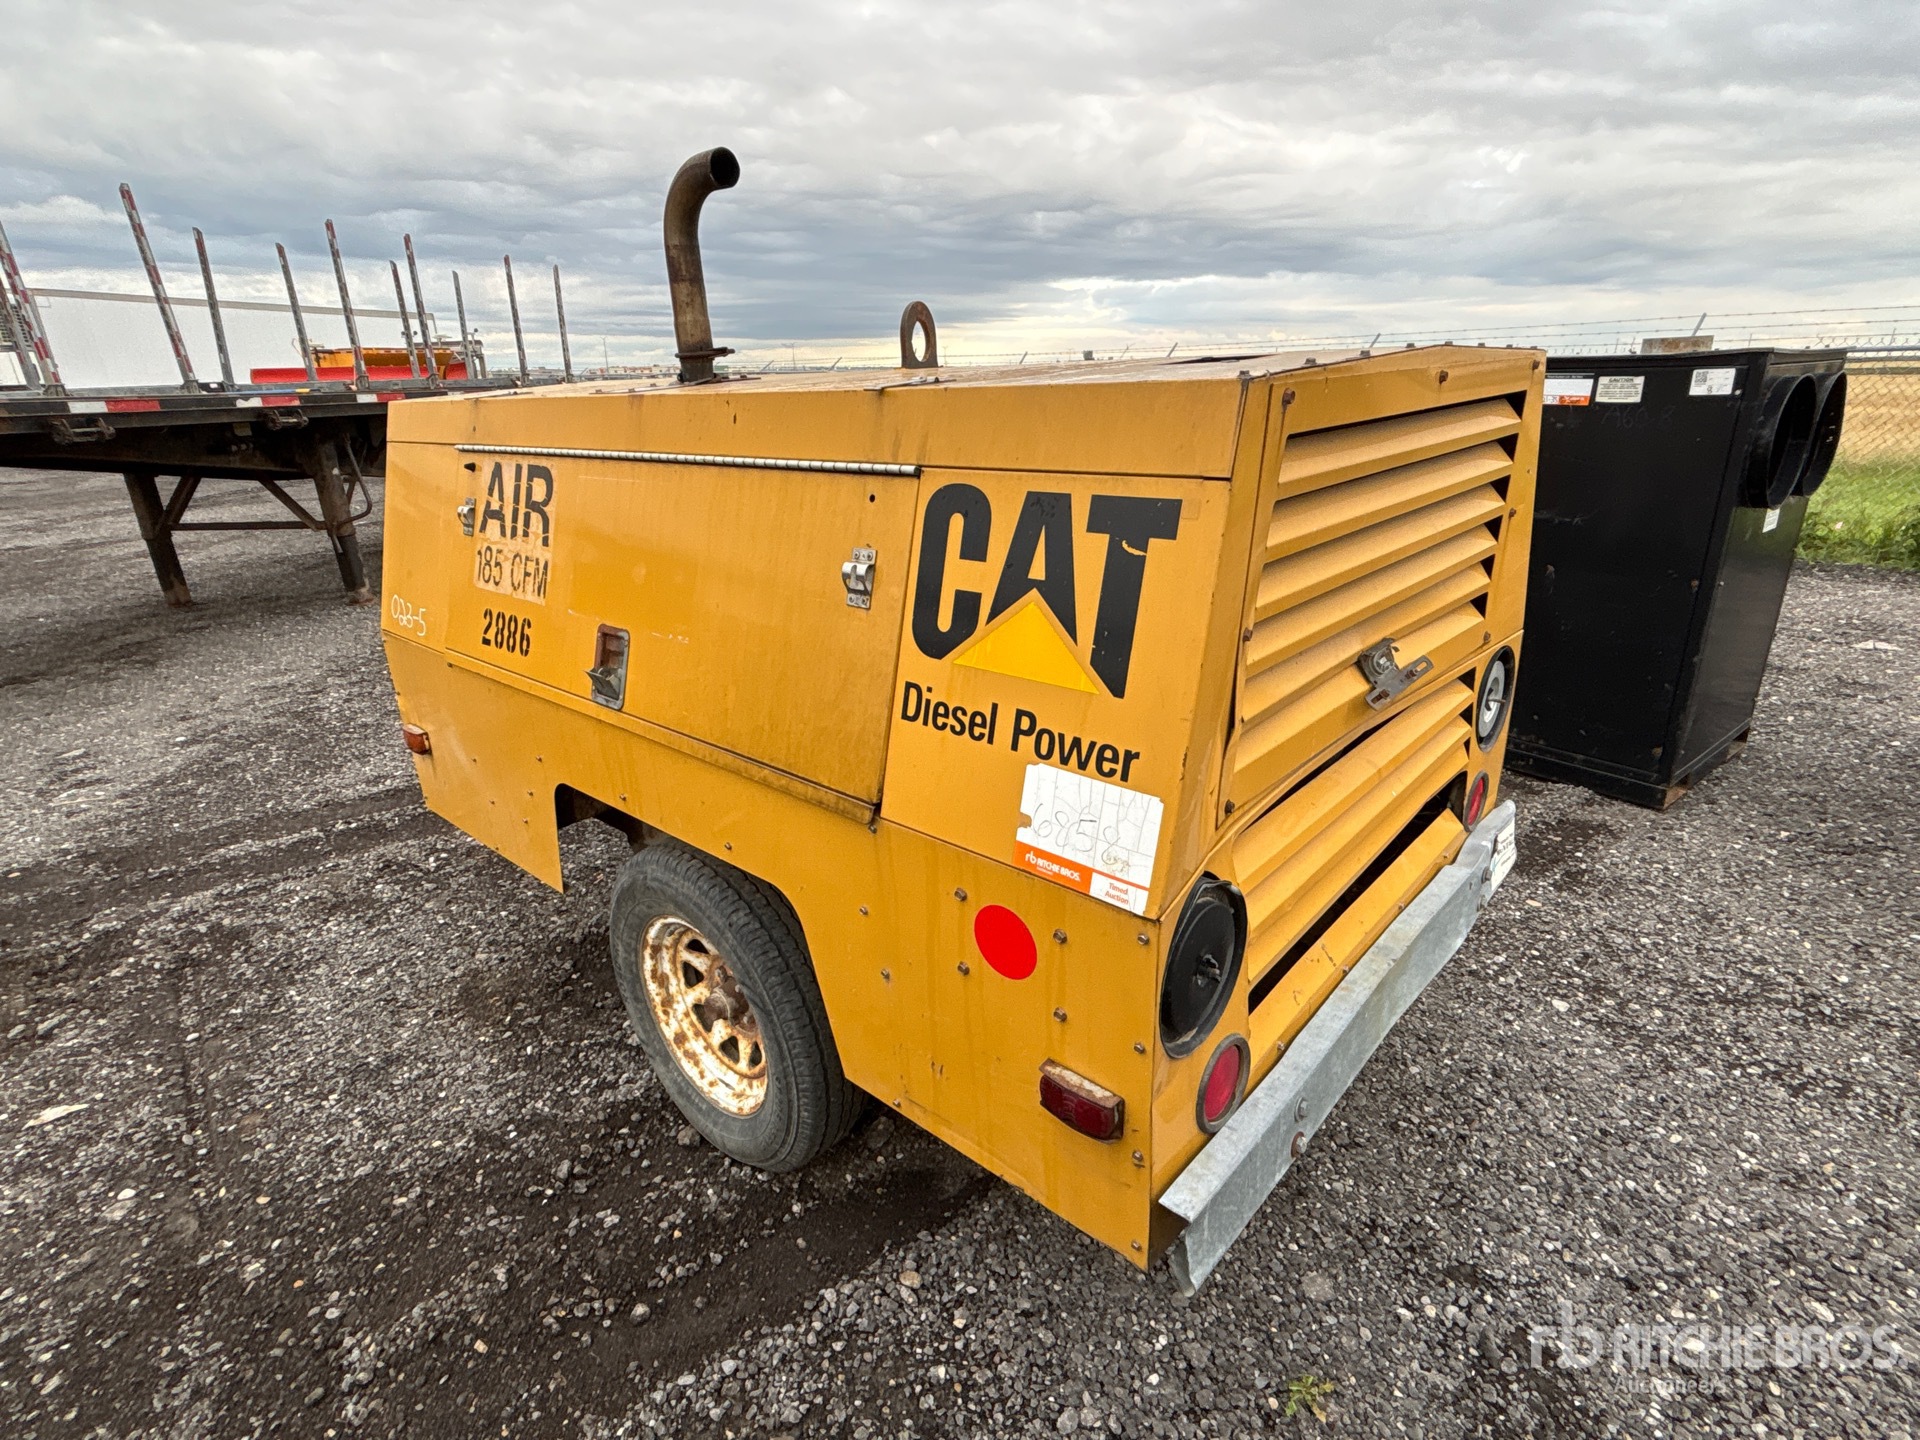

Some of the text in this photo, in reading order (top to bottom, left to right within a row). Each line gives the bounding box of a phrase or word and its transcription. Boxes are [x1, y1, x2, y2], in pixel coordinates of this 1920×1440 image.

[479, 462, 554, 547] AIR
[477, 546, 549, 599] 185 CFM
[912, 483, 1183, 699] CAT
[481, 608, 532, 657] 2886
[901, 681, 1140, 783] Diesel Power
[1037, 857, 1060, 873] RITCHIE
[1109, 882, 1129, 895] Timed
[1105, 890, 1129, 905] Auction
